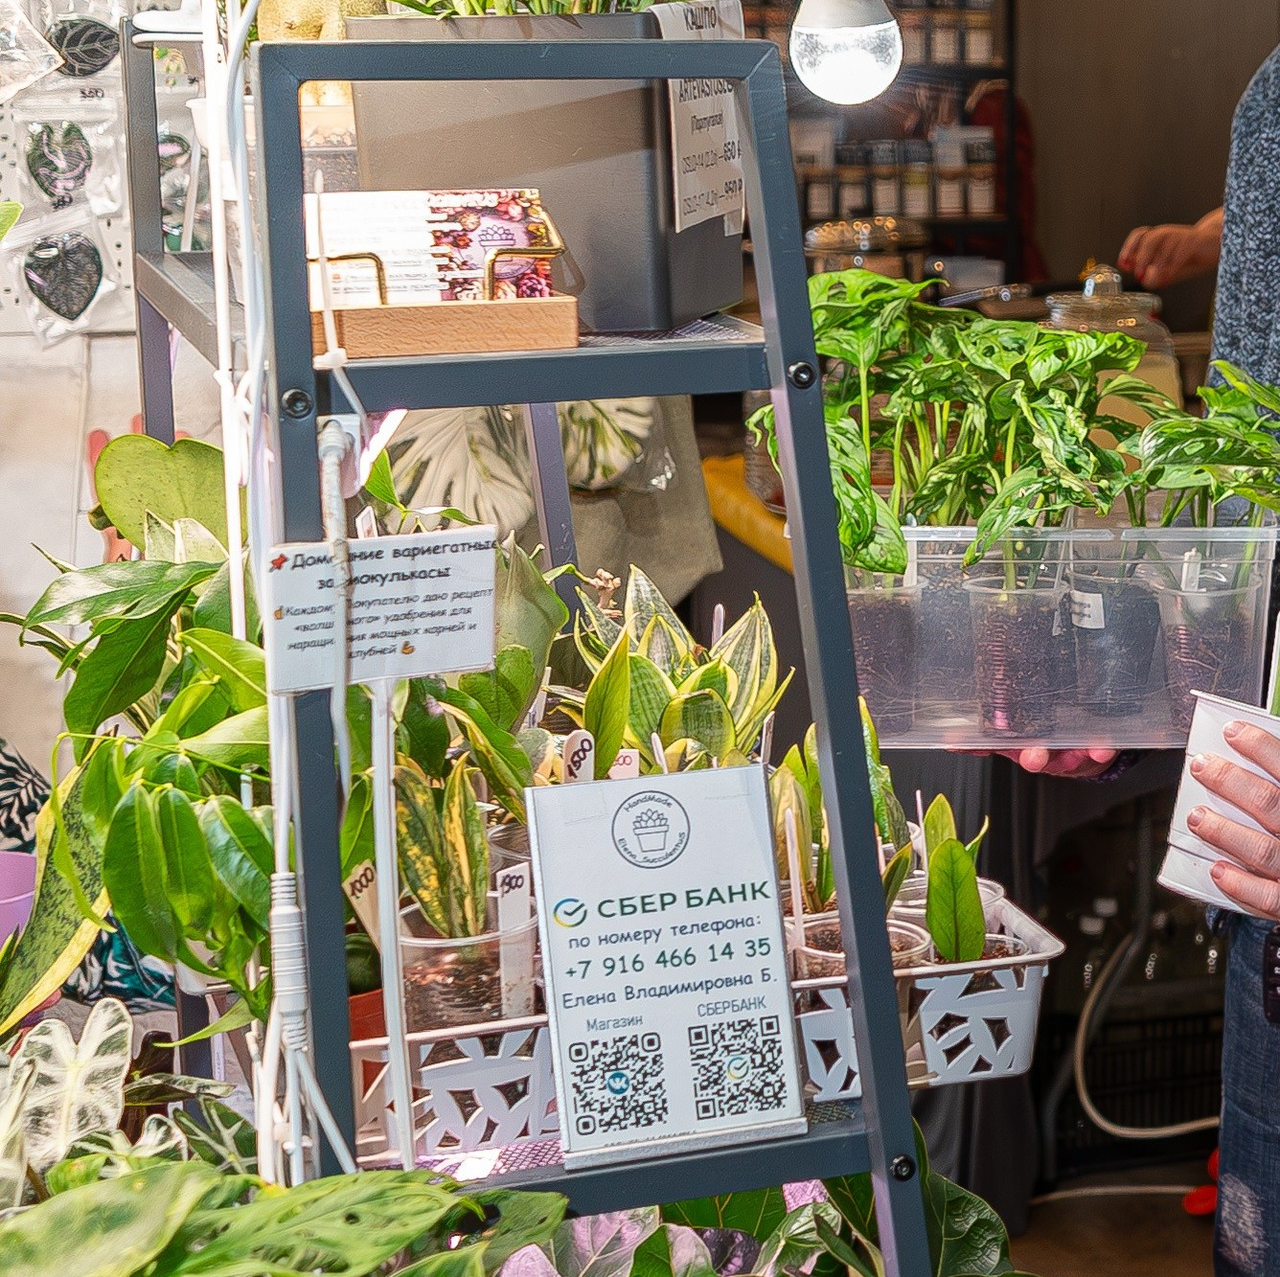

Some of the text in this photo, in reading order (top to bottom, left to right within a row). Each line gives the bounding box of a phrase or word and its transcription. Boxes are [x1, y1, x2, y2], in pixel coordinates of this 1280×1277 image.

[683, 6, 717, 30] КАШПО
[392, 539, 497, 560] вариегатные
[567, 738, 593, 779] 1500
[349, 866, 375, 897] 1000
[597, 880, 771, 918] СБЕР БАНК
[568, 913, 762, 950] по номеру телефона:
[565, 937, 772, 979] +7 916 466 14 35
[562, 968, 779, 1010] Елена Владимировна Б.
[697, 995, 767, 1018] СБЕРБАНК
[586, 1015, 644, 1033] Магазин
